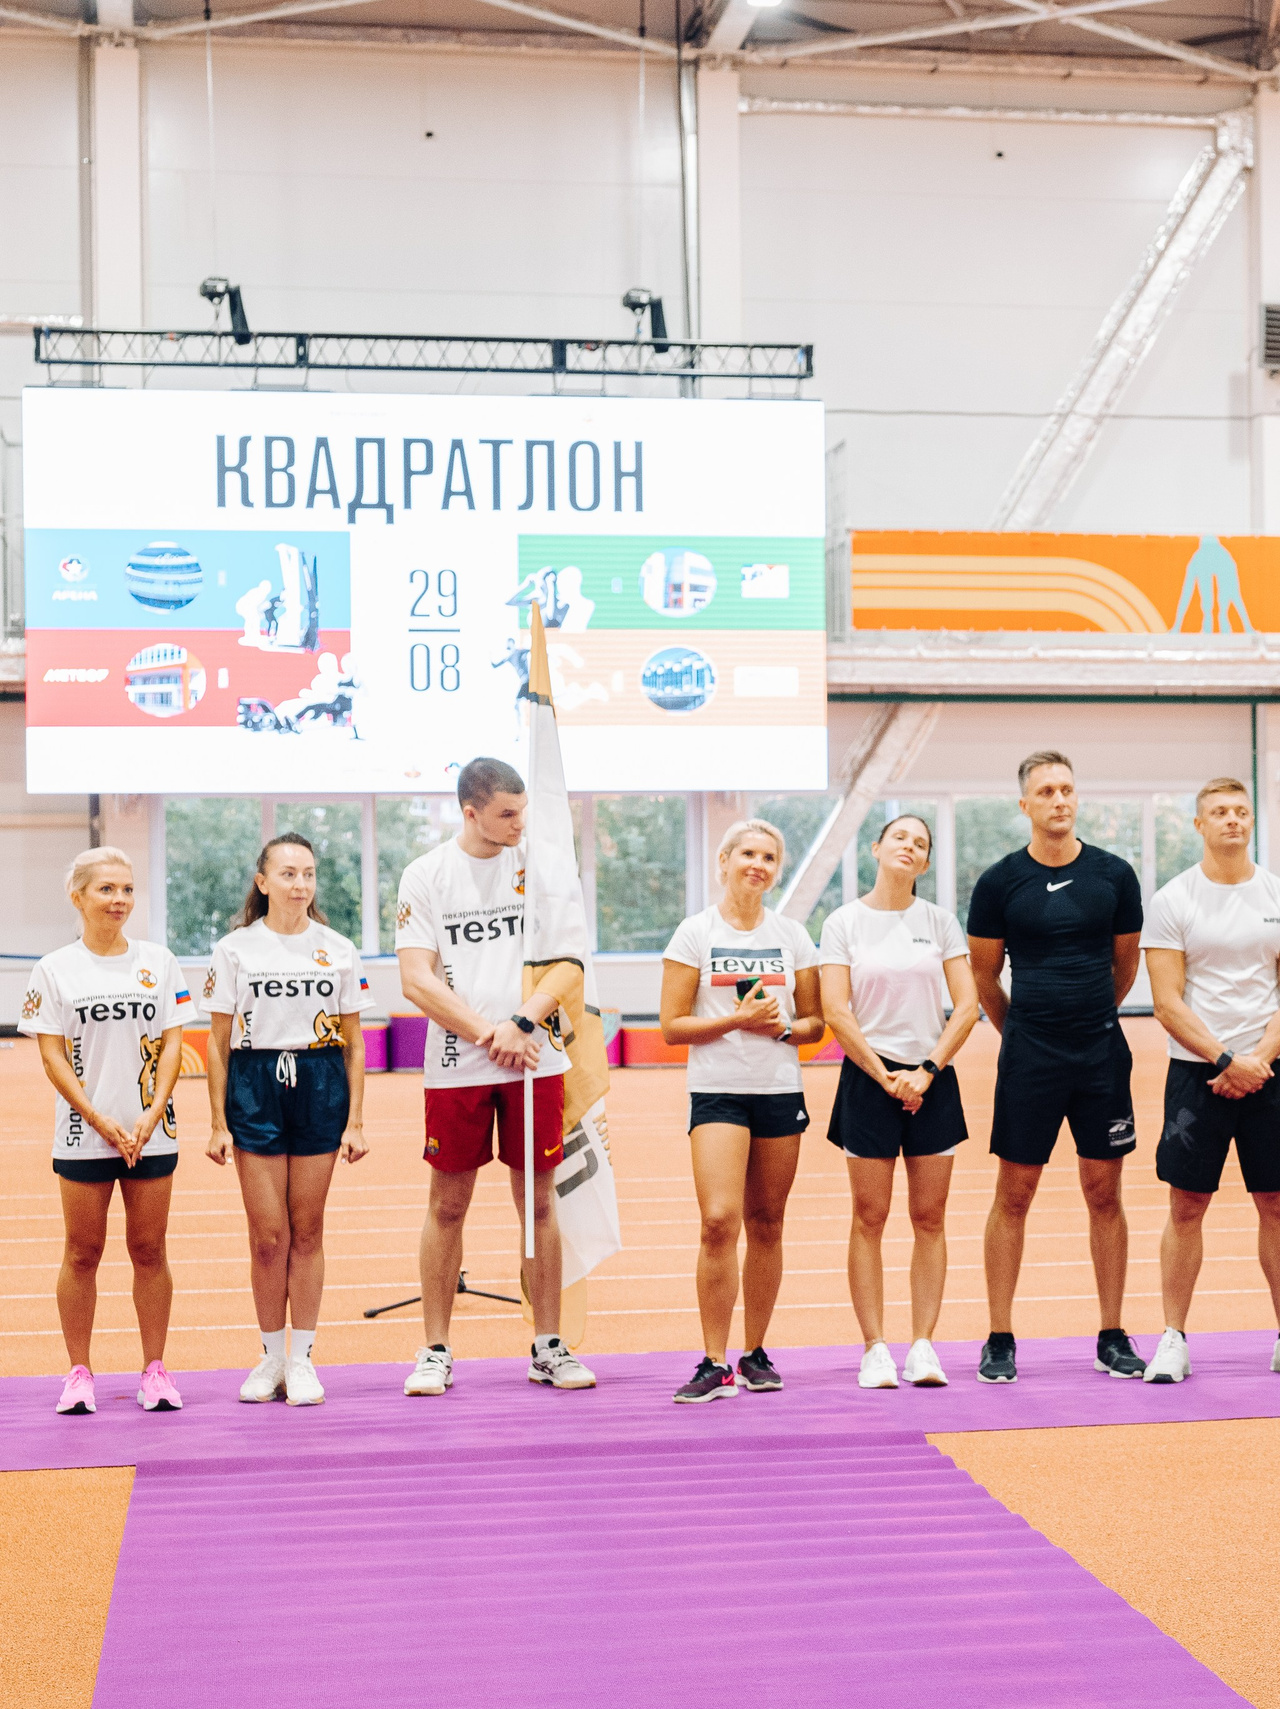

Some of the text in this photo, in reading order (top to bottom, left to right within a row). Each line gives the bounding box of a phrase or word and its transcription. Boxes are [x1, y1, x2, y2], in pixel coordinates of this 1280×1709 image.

[216, 434, 644, 525] КВАДРАТЛОН
[409, 569, 458, 617] 29
[410, 643, 460, 692] 08
